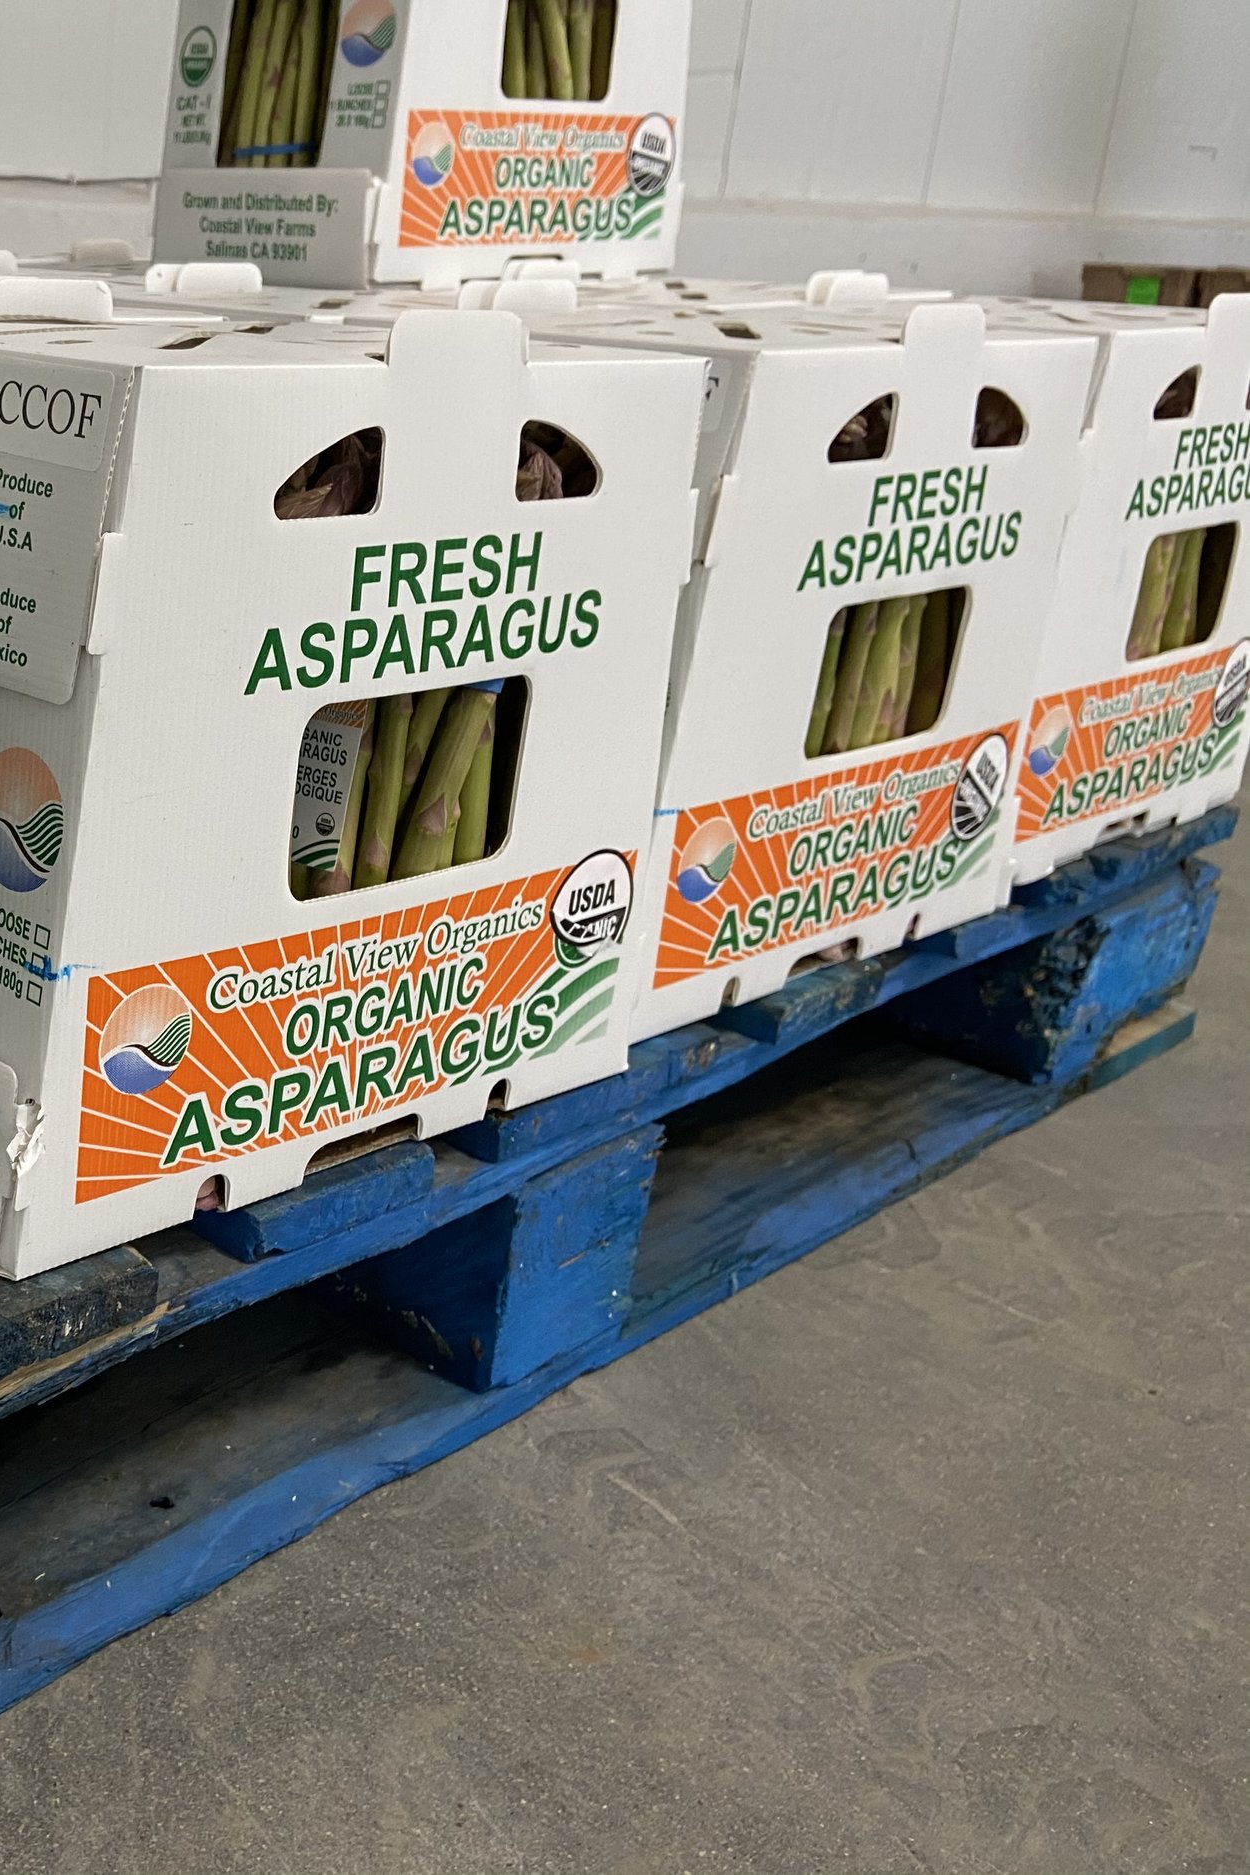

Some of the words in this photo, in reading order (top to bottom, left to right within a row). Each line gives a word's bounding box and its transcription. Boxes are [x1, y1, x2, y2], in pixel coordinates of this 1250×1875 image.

[462, 123, 518, 148] Coastal
[524, 125, 560, 148] View
[564, 128, 625, 152] Organics
[495, 156, 594, 188] ORGANIC
[183, 191, 219, 209] Grown
[220, 193, 243, 210] and
[245, 193, 314, 212] Distributed
[316, 194, 338, 217] By:
[199, 216, 242, 234] Coastal
[245, 217, 273, 235] View
[276, 219, 317, 237] Farms
[439, 198, 633, 237] ASPARAGUS
[206, 240, 248, 258] Salinas
[251, 242, 269, 259] CA
[273, 243, 308, 261] 93901
[1174, 422, 1250, 471] FRESH
[9, 501, 26, 520] of
[868, 464, 988, 527] FRESH
[351, 531, 543, 612] FRESH
[796, 510, 1022, 592] ASPARAGUS
[244, 589, 602, 695] ASPARAGUS
[299, 742, 347, 766] RAGUS
[1104, 701, 1192, 758] ORGANIC
[749, 795, 824, 839] Coastal
[832, 784, 879, 816] View
[883, 759, 961, 803] Organics
[1042, 730, 1216, 825] ASPARAGUS
[791, 803, 917, 876] ORGANIC
[569, 879, 615, 916] USDA
[708, 839, 959, 961] ASPARAGUS
[211, 949, 333, 1010] Coastal
[344, 935, 419, 975] View
[426, 896, 542, 955] Organics
[285, 958, 484, 1056] ORGANIC
[162, 994, 556, 1166] ASPARAGUS
